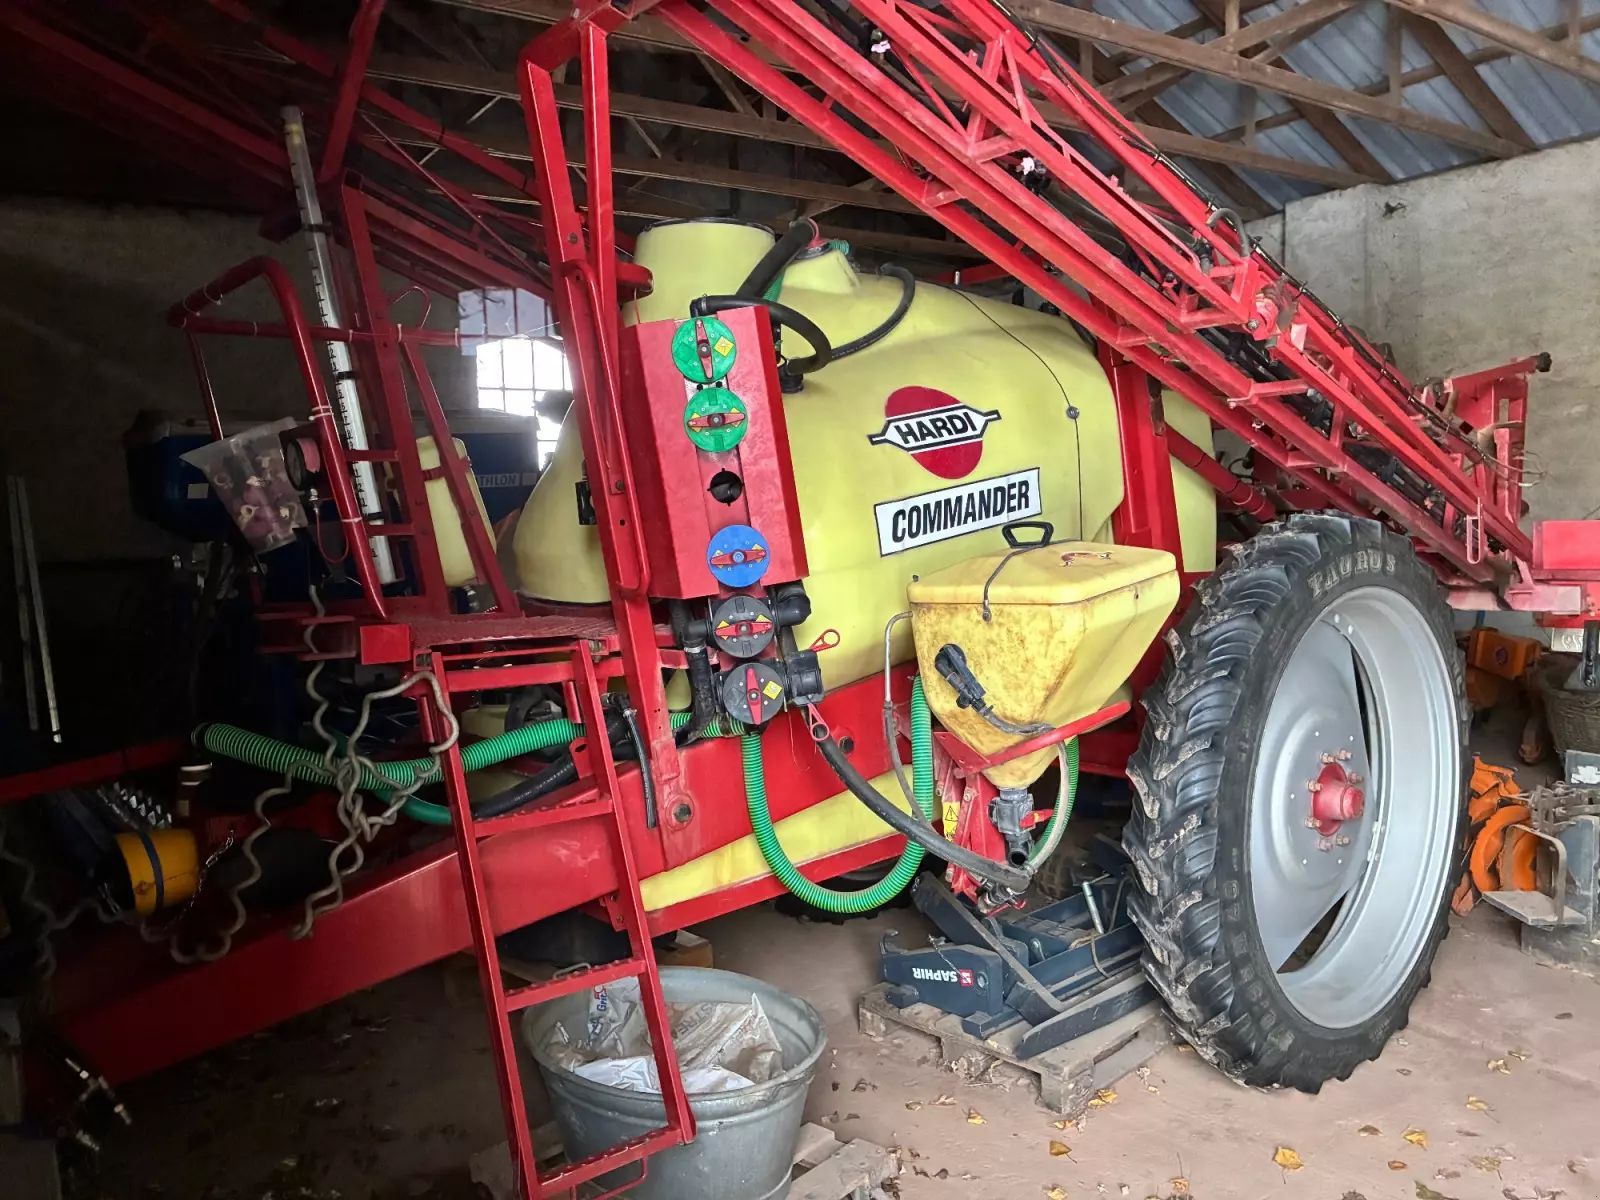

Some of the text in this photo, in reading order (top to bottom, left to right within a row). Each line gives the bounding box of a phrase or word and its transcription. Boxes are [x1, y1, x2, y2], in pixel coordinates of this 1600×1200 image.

[894, 411, 977, 445] HARDI
[479, 474, 518, 488] THLON
[892, 479, 1030, 543] COMMANDER
[1306, 548, 1396, 599] TAURUS
[912, 967, 958, 983] SAPHIR
